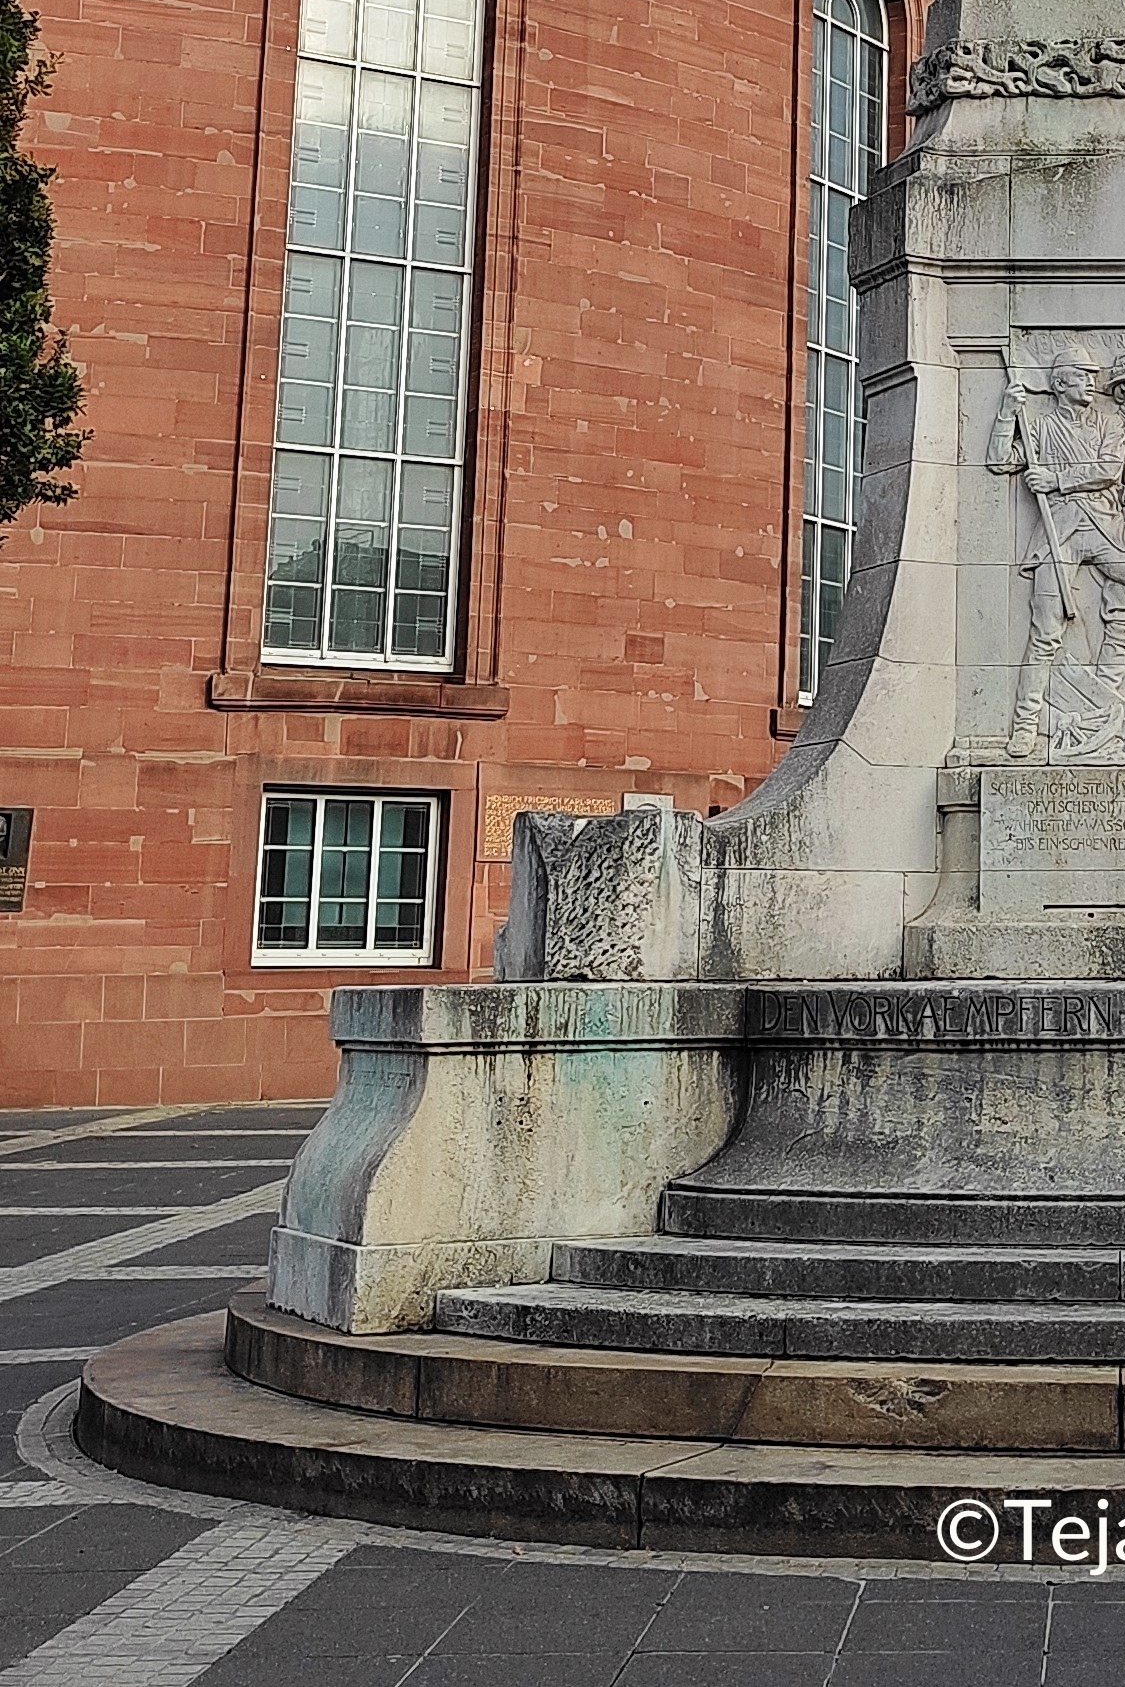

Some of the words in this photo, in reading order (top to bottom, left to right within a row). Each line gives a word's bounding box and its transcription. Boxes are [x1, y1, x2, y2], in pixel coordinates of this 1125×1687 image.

[1038, 837, 1060, 851] EIN
[760, 990, 820, 1033] DEN
[826, 991, 1113, 1034] VORKAEMPFERN
